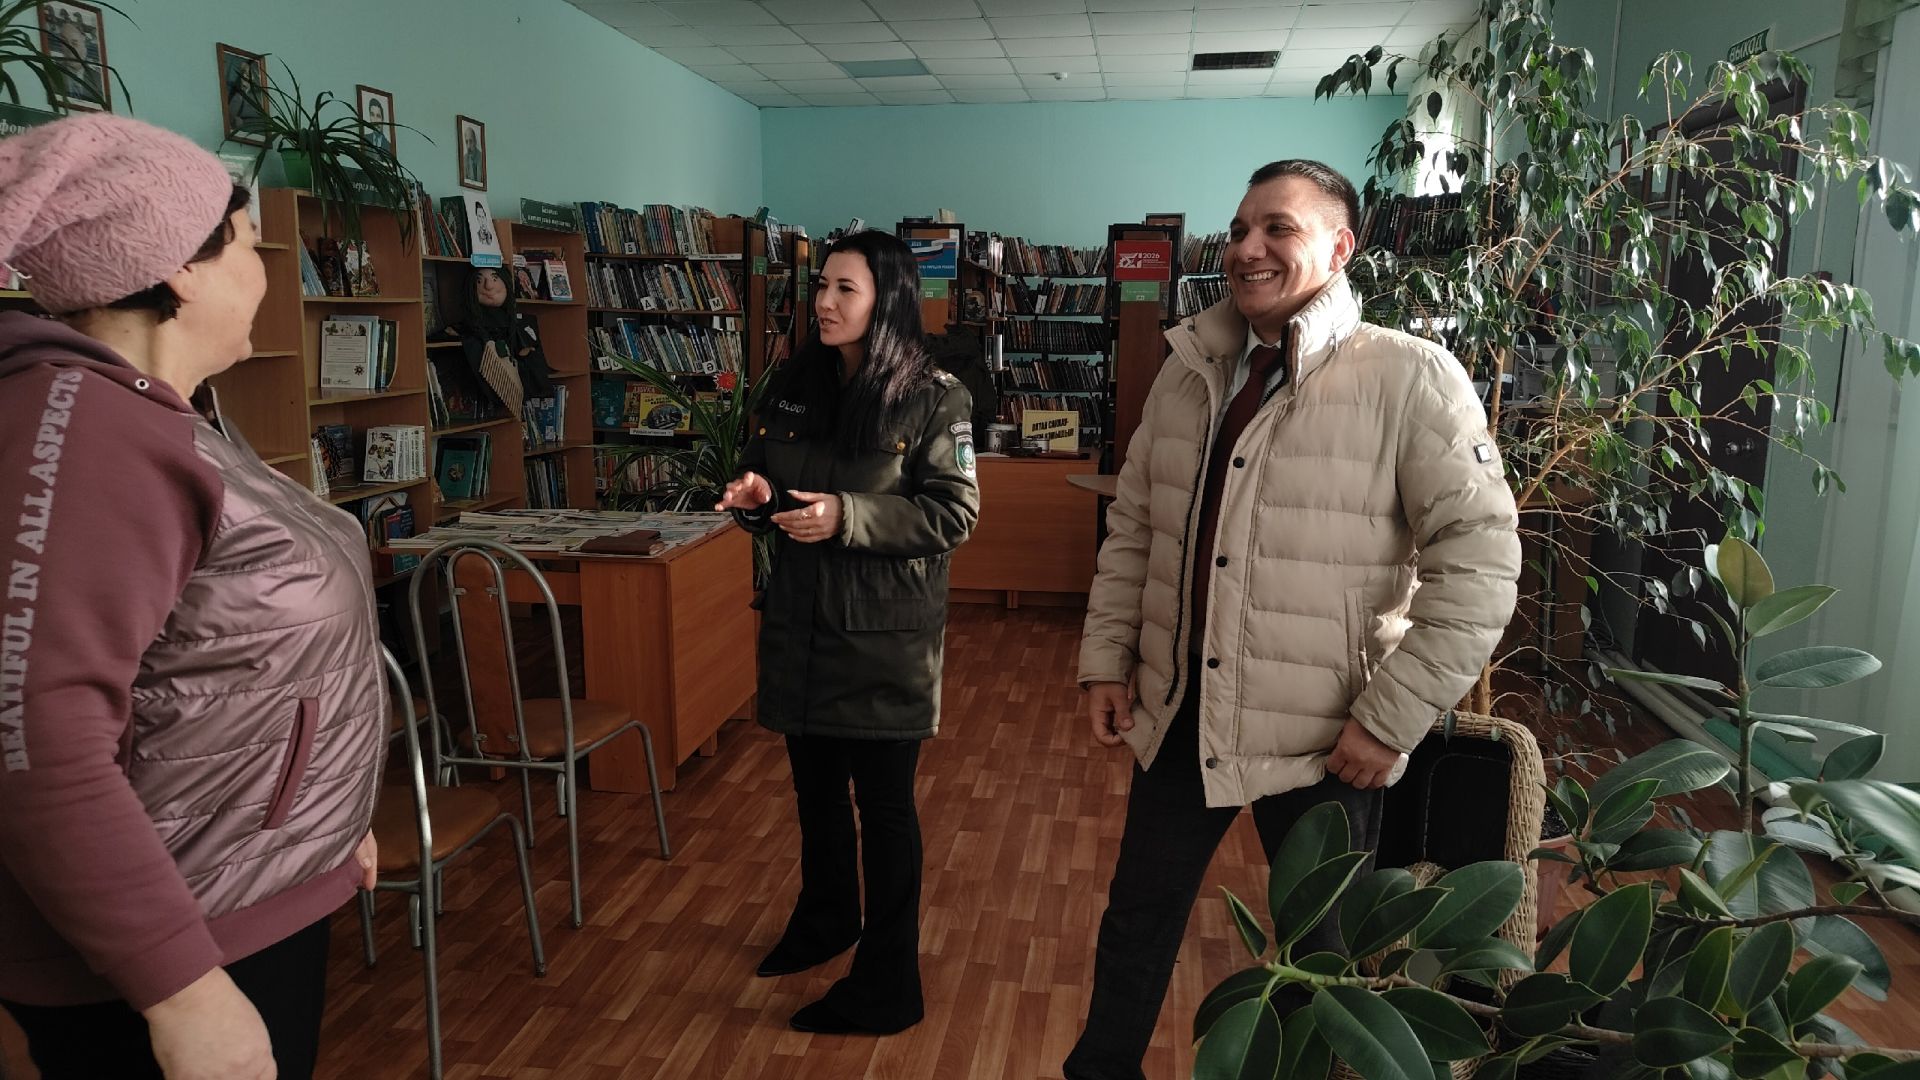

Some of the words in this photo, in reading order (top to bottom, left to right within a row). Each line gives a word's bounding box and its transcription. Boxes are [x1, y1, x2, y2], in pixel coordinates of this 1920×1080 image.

[1730, 32, 1763, 62] ВЫХОД
[28, 371, 84, 487] ASPECTS
[15, 488, 54, 555] ALL
[8, 560, 41, 602] IN
[0, 607, 35, 772] BEATIFUL
